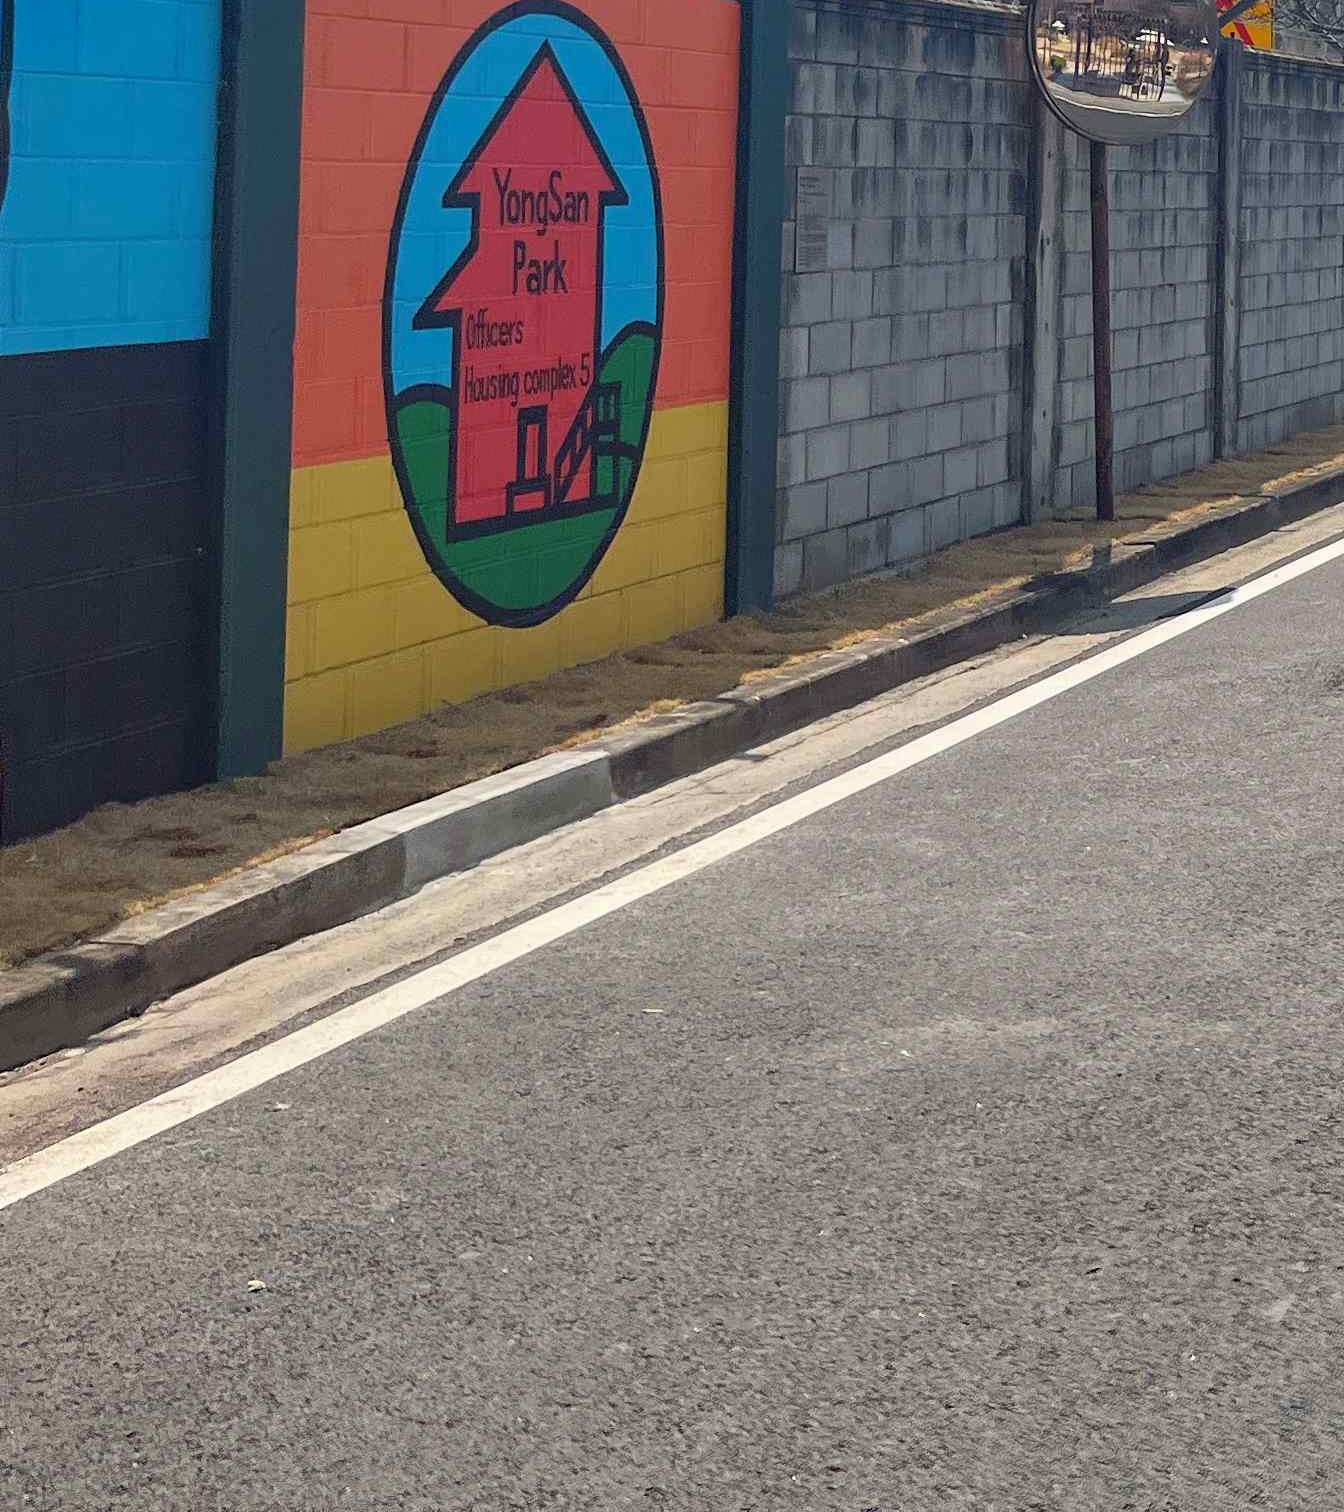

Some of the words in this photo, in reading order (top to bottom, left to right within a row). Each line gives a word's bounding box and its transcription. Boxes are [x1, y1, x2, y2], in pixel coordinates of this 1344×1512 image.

[494, 167, 589, 236] YongSan
[511, 239, 569, 296] Park
[465, 308, 524, 350] Officers
[464, 364, 519, 407] Housing
[523, 356, 577, 400] complex
[579, 352, 591, 387] 5
